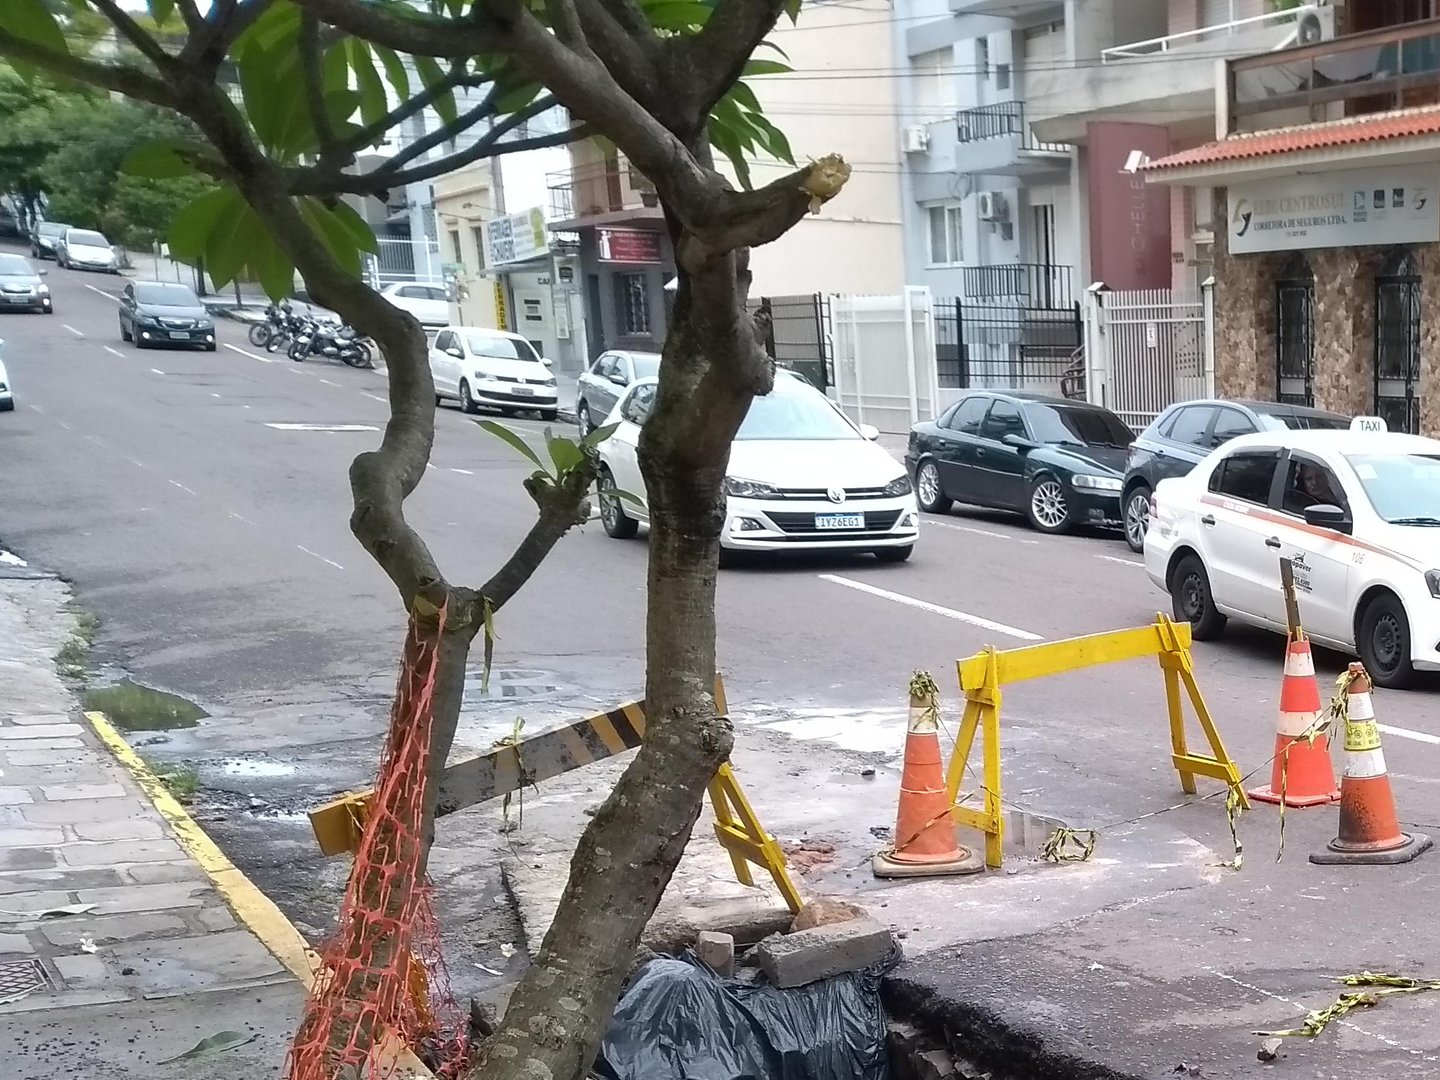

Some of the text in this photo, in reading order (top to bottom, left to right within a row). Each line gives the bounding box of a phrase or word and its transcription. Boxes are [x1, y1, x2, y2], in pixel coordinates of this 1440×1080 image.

[1254, 219, 1287, 231] CORRETORA
[1287, 218, 1295, 228] DE
[1296, 216, 1326, 228] SEGUROS
[1359, 420, 1381, 432] TAXI
[1352, 552, 1366, 565] 106
